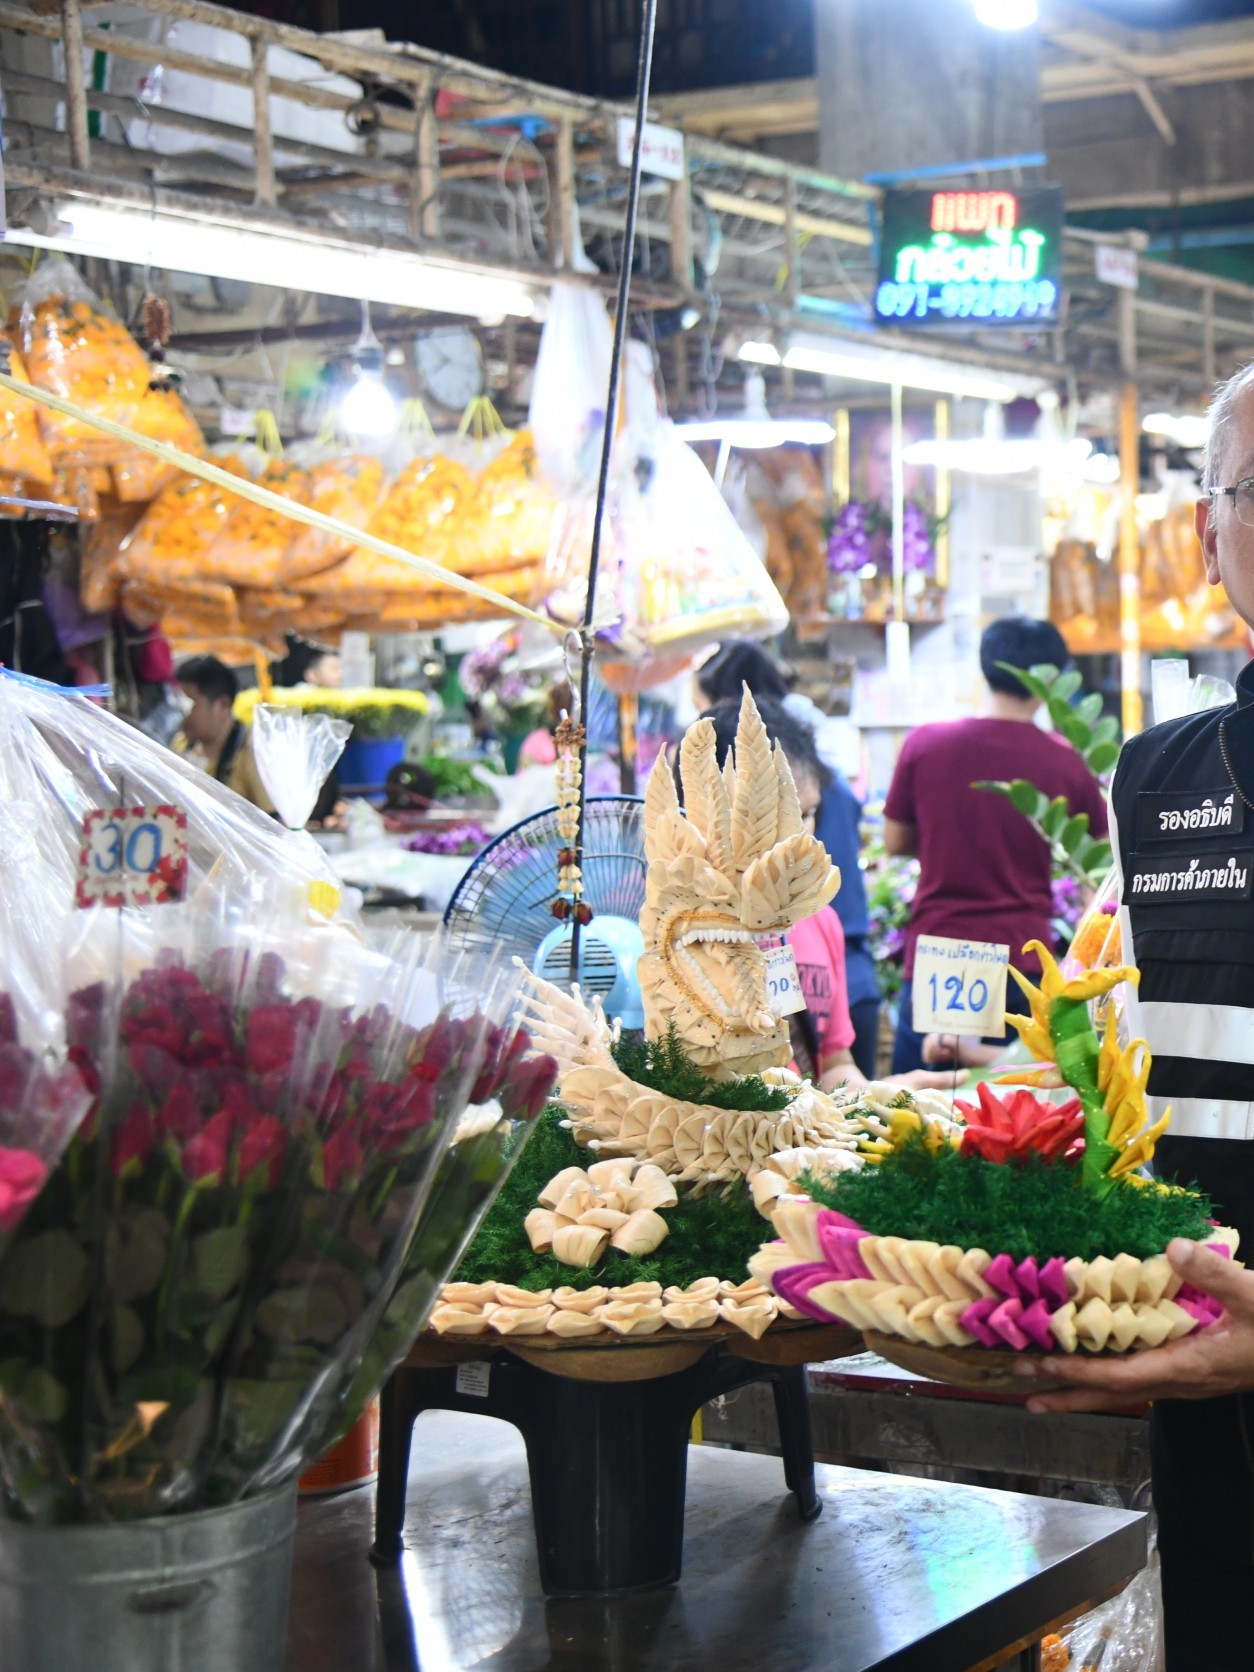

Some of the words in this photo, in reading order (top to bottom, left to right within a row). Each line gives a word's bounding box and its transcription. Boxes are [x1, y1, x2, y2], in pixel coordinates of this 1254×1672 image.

[1159, 793, 1235, 831] รองอธิบดี
[95, 823, 163, 874] 30
[1131, 857, 1248, 893] กรมการค้าภายใน
[929, 973, 988, 1013] 120
